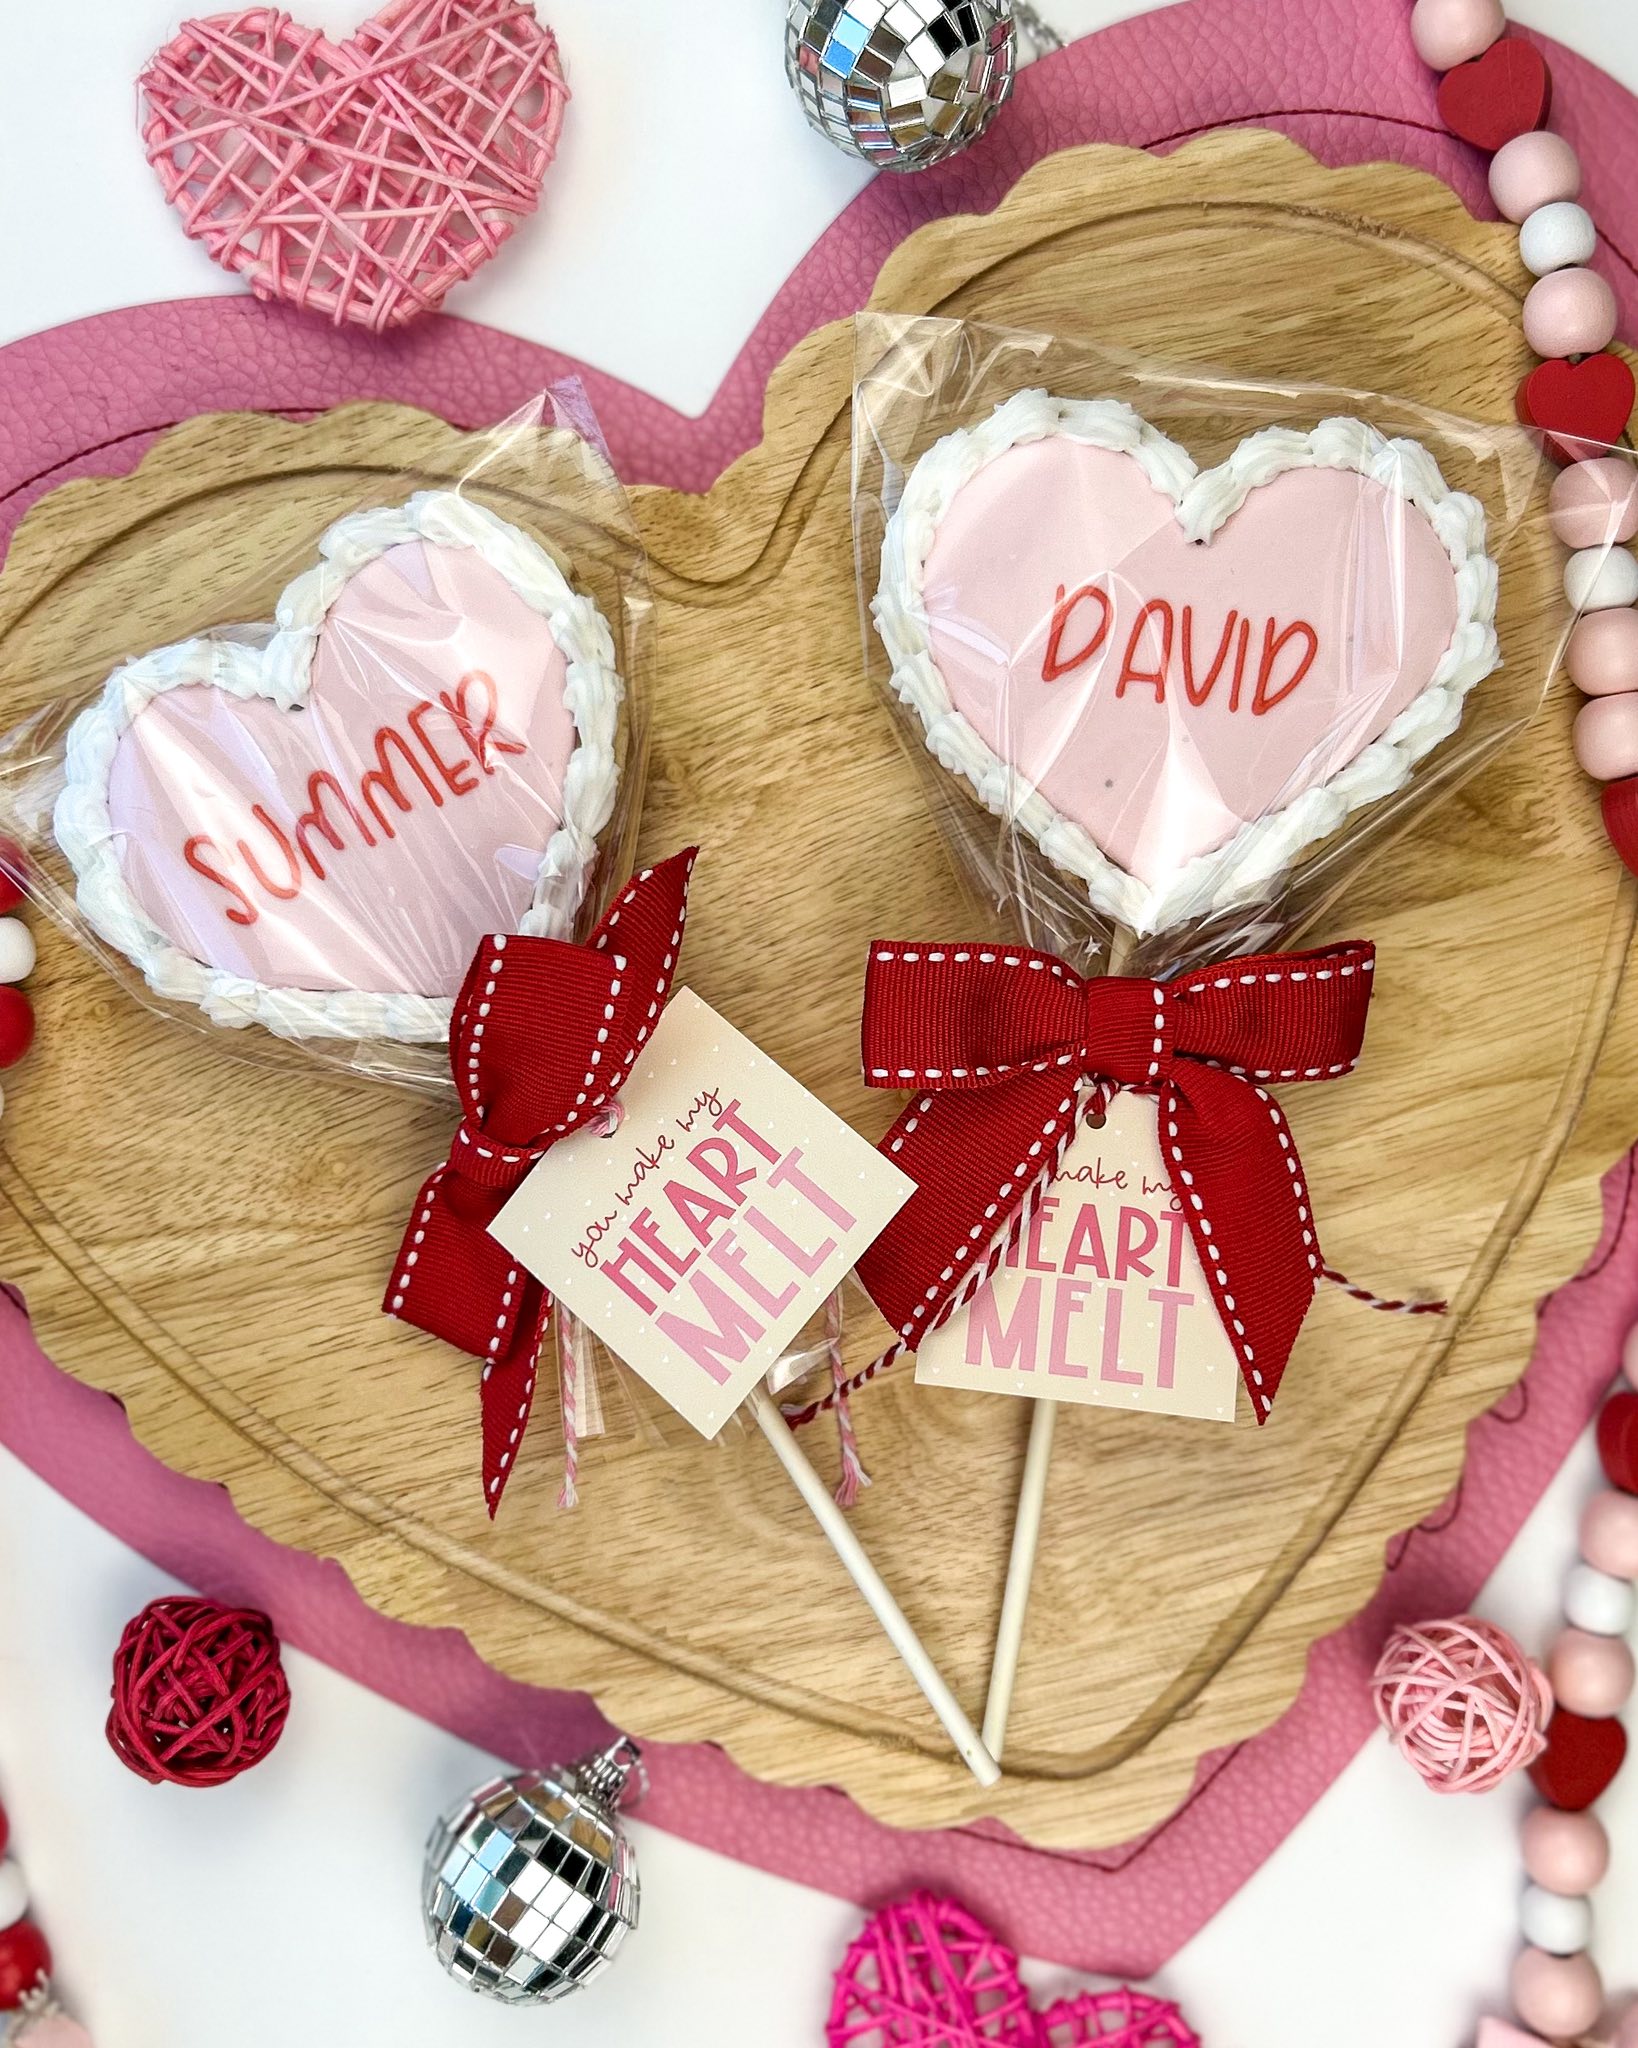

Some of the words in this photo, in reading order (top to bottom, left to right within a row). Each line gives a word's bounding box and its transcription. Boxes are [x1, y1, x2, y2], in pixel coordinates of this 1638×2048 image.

[1041, 584, 1318, 716] DAVID
[184, 670, 526, 925] SUMMER
[571, 1210, 617, 1267] you
[615, 1135, 674, 1205] make
[676, 1088, 722, 1132] my
[600, 1099, 782, 1316] HEART
[655, 1146, 857, 1386] MELT
[965, 1276, 1195, 1389] MELT
